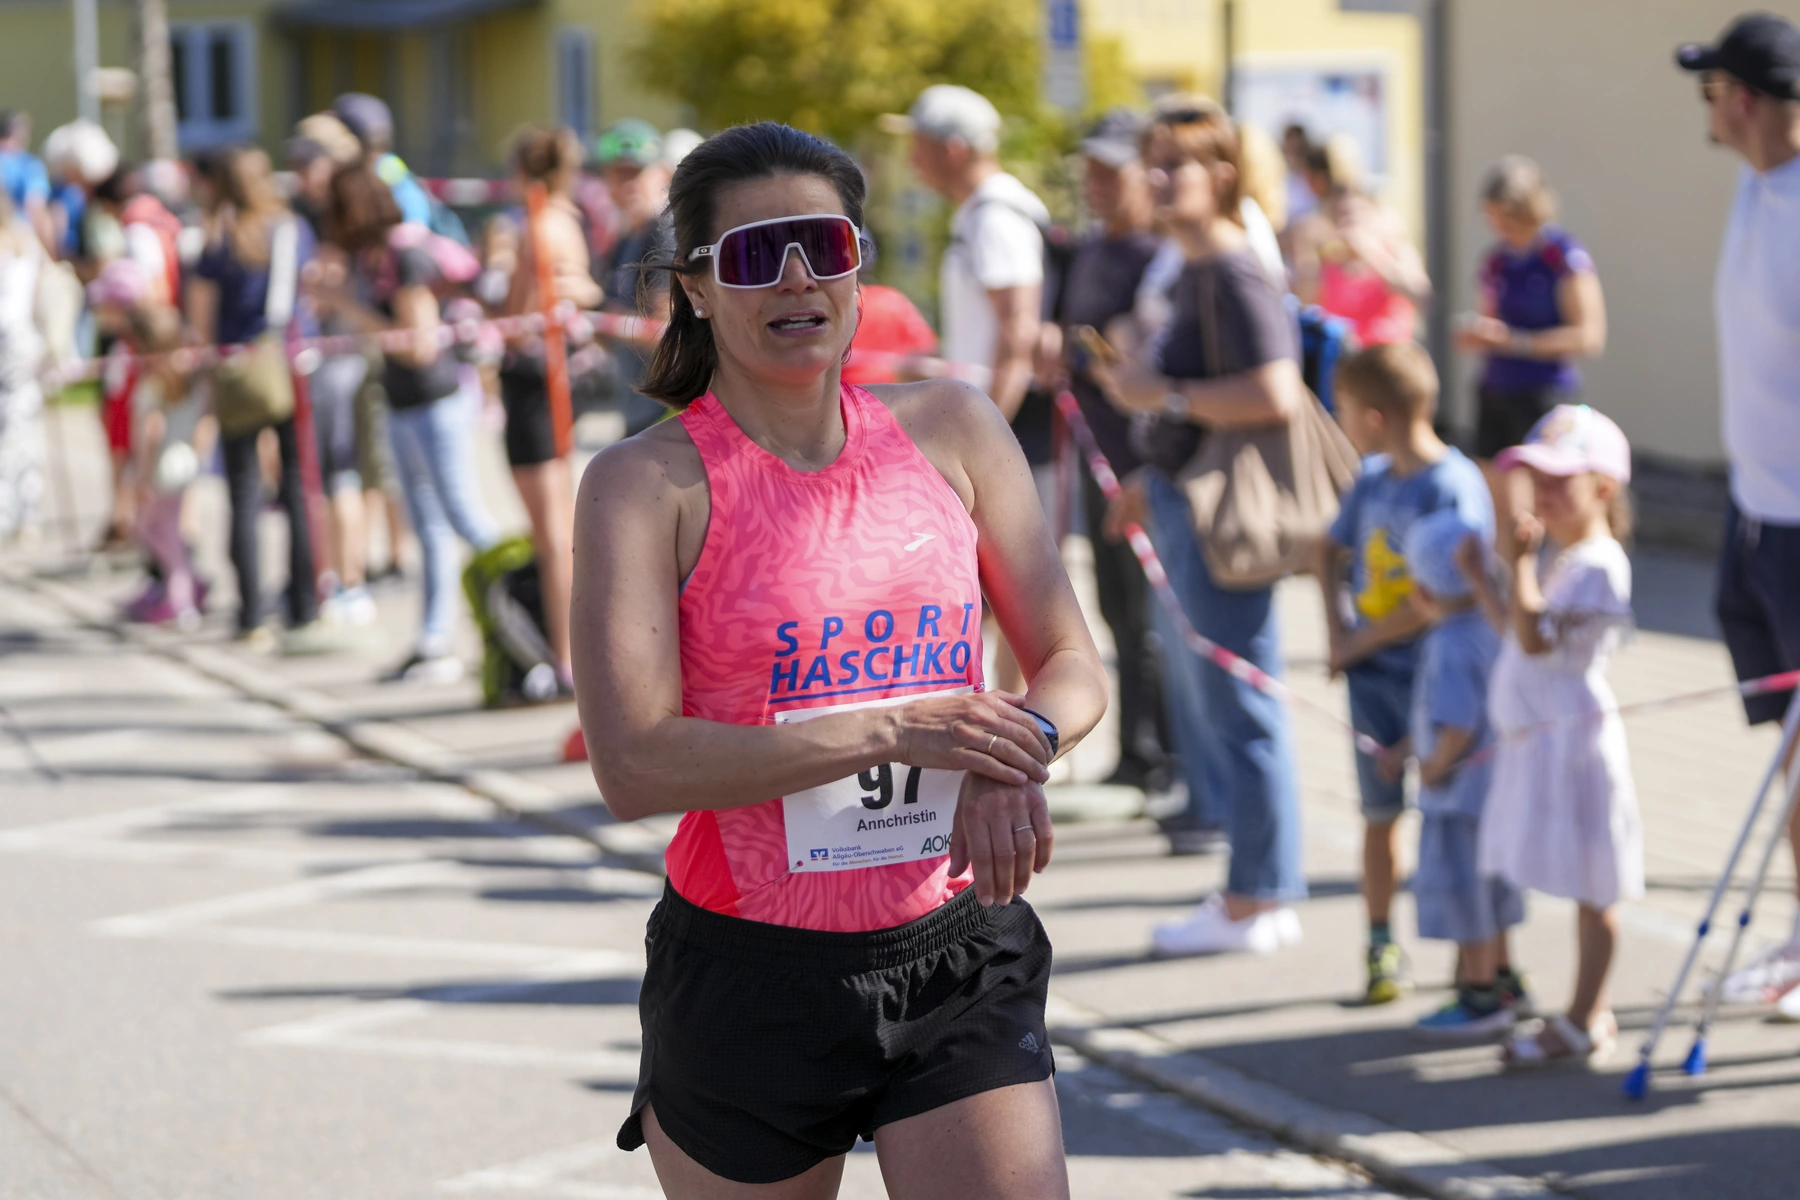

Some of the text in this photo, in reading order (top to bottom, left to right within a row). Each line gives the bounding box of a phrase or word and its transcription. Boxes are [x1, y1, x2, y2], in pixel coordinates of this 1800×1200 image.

[770, 640, 971, 694] HASCHKO
[857, 761, 922, 810] 97
[857, 809, 937, 832] Annchristin
[831, 844, 862, 853] Volksbank
[832, 847, 896, 861] Allgäu-Oberschwaben
[920, 832, 953, 855] AOK
